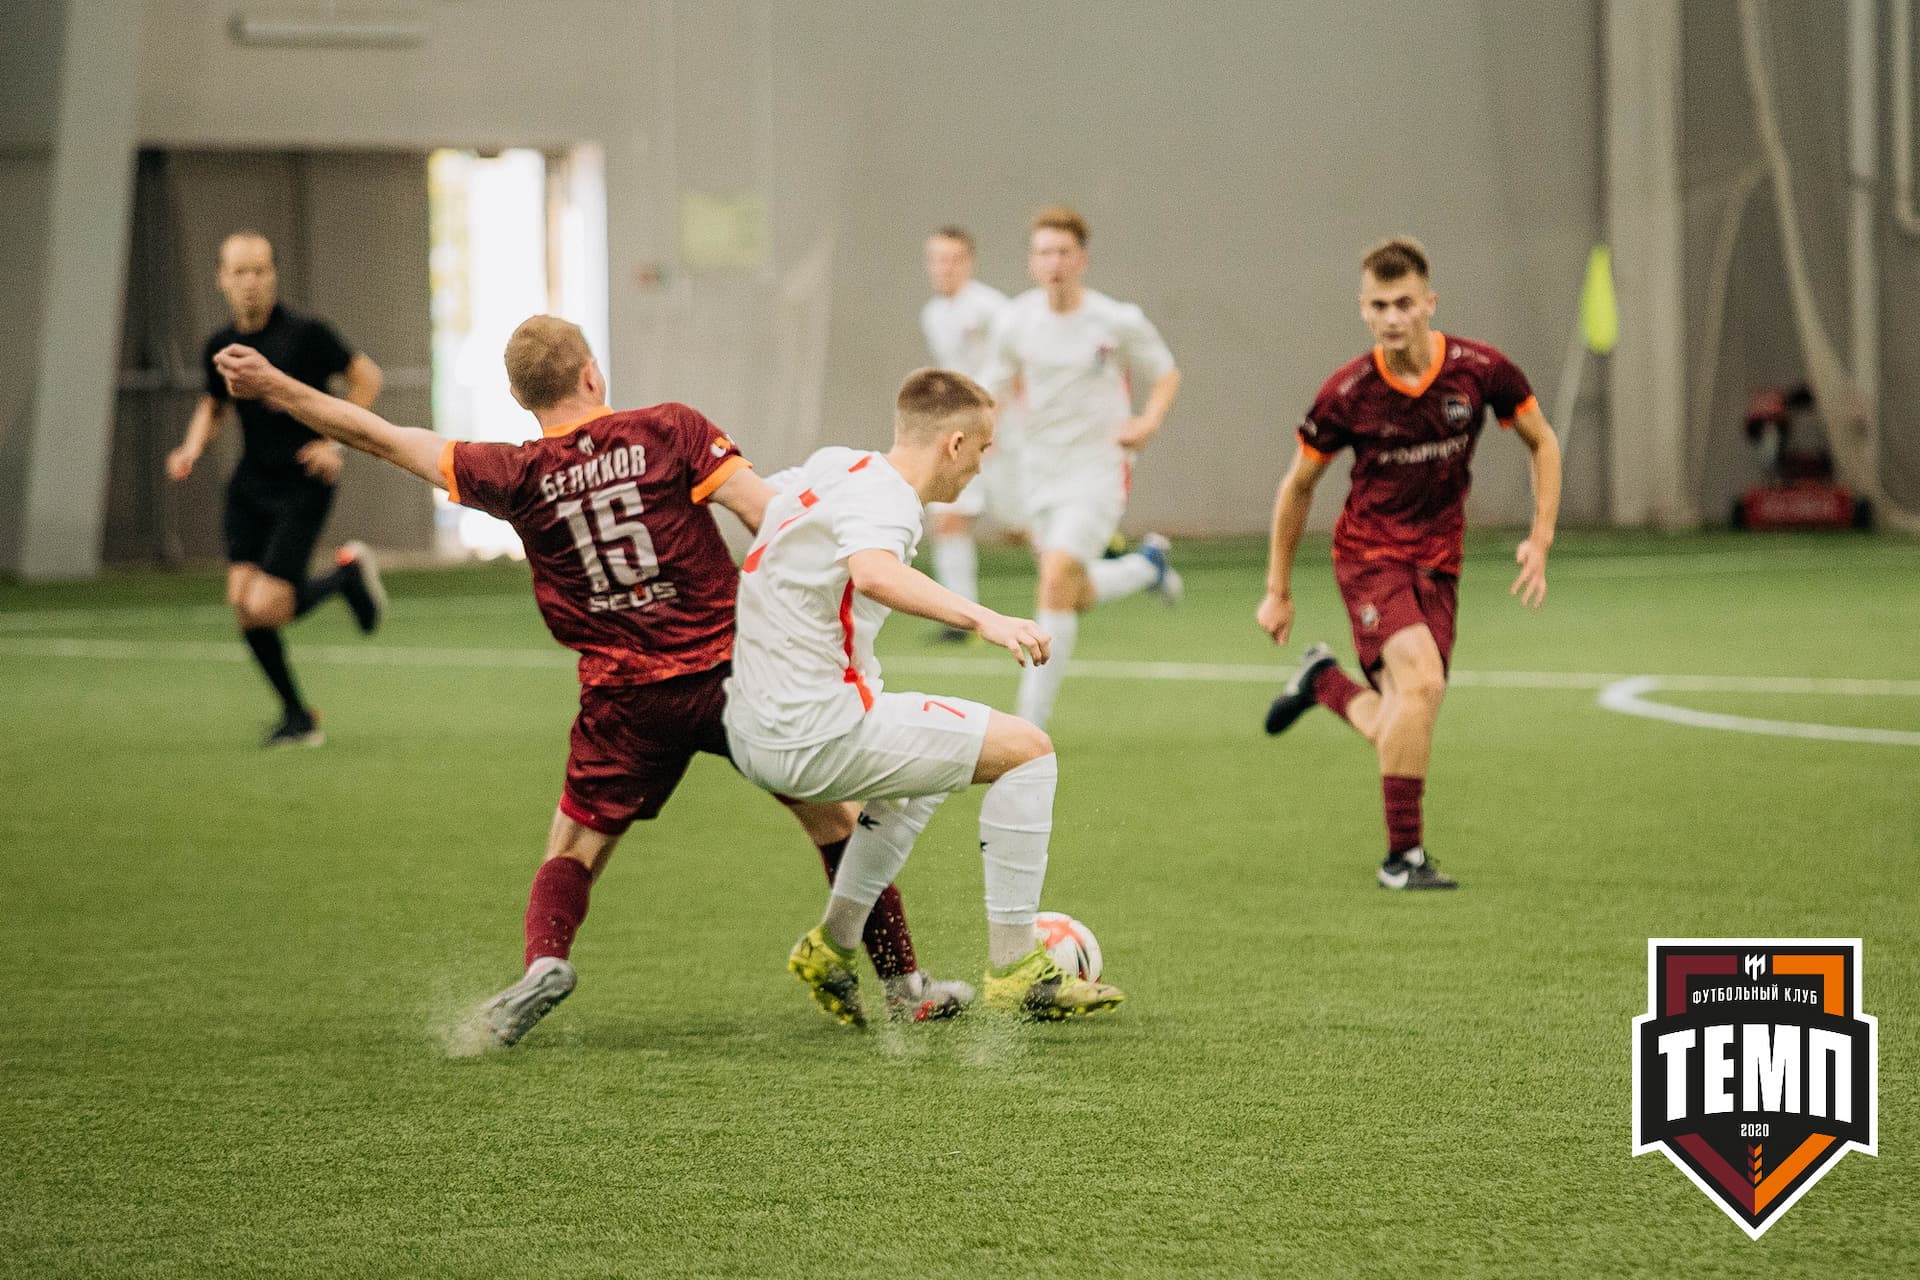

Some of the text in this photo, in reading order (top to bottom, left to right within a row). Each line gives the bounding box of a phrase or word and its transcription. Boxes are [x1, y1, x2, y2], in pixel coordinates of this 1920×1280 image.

[556, 481, 660, 593] 15
[588, 581, 678, 613] SEUS
[923, 700, 967, 720] 7
